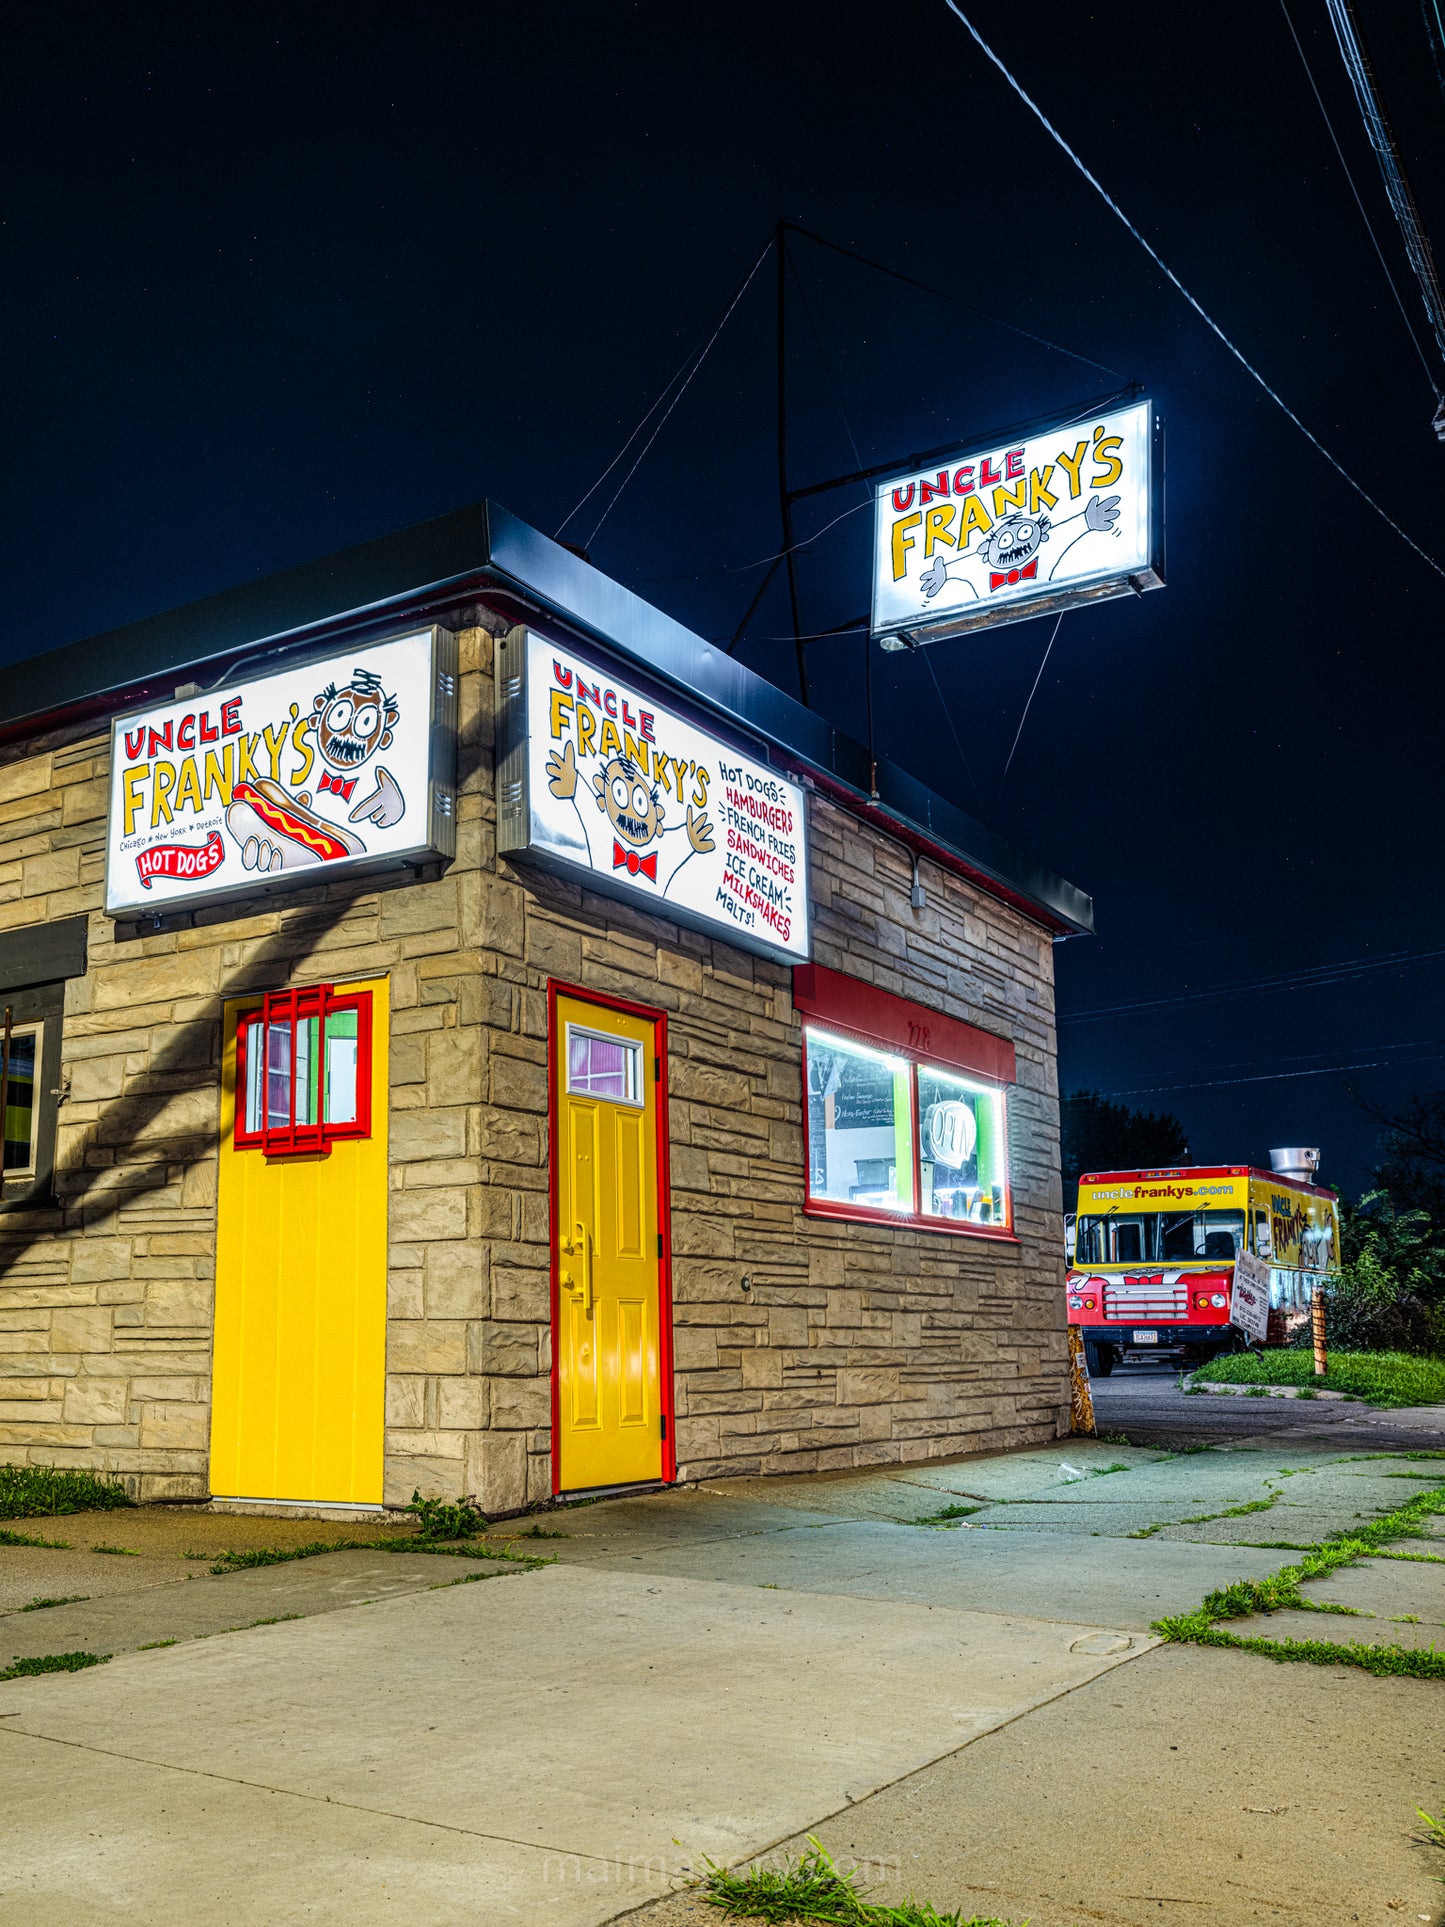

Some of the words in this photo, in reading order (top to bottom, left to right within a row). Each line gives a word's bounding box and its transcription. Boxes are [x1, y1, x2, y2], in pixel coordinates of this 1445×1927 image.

[891, 425, 1124, 582] FRANKY'S
[892, 448, 1025, 512] UNCLE
[124, 696, 243, 760] UNCLE
[552, 658, 655, 743] UNCLE
[122, 703, 315, 838] FRANKY'S
[549, 687, 711, 809] FRANKY'S
[718, 760, 743, 787] HOT
[745, 773, 779, 802] DOGS
[725, 786, 793, 836] HAMBURGERS
[141, 850, 175, 875] HOT
[176, 844, 220, 875] DOGS
[726, 806, 766, 844] FRENCH
[767, 833, 796, 865] FRIES
[727, 828, 795, 884] SANDWICHES
[722, 869, 791, 942] MILKSHAKES
[725, 851, 746, 879] ICE
[749, 866, 784, 910] CREAM
[1091, 1183, 1234, 1200] unclefrankys.com
